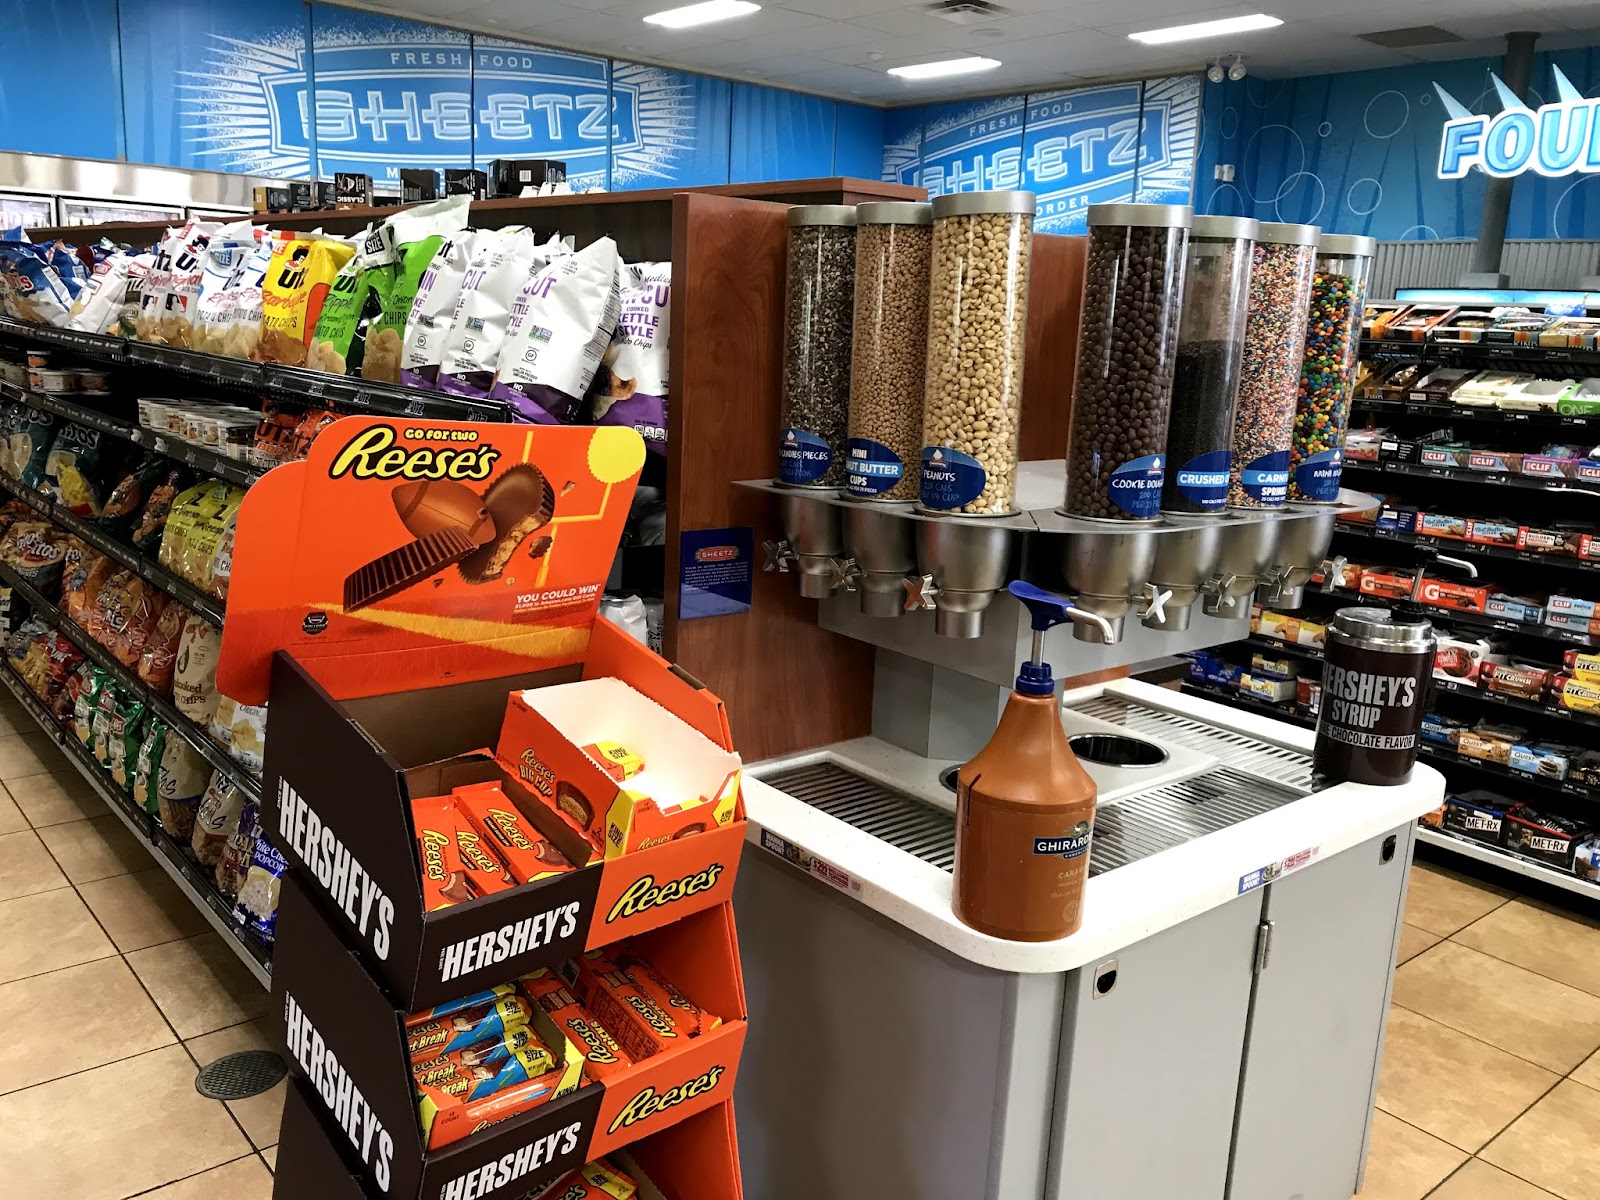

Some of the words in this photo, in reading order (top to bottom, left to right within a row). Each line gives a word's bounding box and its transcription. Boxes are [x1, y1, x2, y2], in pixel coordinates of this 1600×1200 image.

[390, 52, 463, 66] FRESH
[478, 53, 534, 69] FOOD
[297, 90, 619, 142] SHEETZ
[969, 115, 1018, 137] FRESH
[1031, 101, 1073, 121] FOOD
[913, 117, 1147, 201] SHEETZ
[1036, 195, 1090, 216] ORDER
[365, 240, 384, 254] SIZE
[215, 252, 232, 266] SIZE
[420, 270, 438, 292] IN
[462, 269, 487, 291] CUT
[641, 284, 671, 308] CU
[512, 303, 530, 315] TTLE
[384, 311, 407, 325] CHIPS
[619, 325, 654, 339] STYLE
[633, 339, 653, 349] Chips
[456, 373, 466, 381] NO
[512, 383, 524, 392] NO
[1560, 403, 1593, 415] ONE
[257, 420, 295, 443] UTZ
[257, 442, 282, 455] BBQ
[331, 426, 500, 480] Reese's
[802, 451, 829, 461] PIECES
[852, 447, 868, 459] MINI
[1427, 453, 1446, 461] CLIF
[1475, 458, 1495, 466] CLIF
[861, 462, 899, 475] BUTTER
[1313, 469, 1332, 478] MINI
[1530, 463, 1550, 472] CLIF
[1586, 469, 1600, 477] CLI
[850, 475, 868, 486] CUPS
[923, 469, 956, 482] PEANUTS
[1180, 473, 1225, 485] CRUSHED
[1111, 479, 1145, 489] COOKIE
[942, 493, 960, 502] CUP
[701, 549, 733, 558] SHEETZ
[1582, 539, 1590, 555] CLIF
[1361, 576, 1375, 591] G
[516, 593, 539, 604] YOU
[541, 588, 576, 600] COULD
[1424, 584, 1440, 600] G
[541, 597, 572, 606] Amazon.com
[1323, 660, 1416, 708] HERSHEY'S
[1494, 671, 1505, 680] FIT
[1506, 673, 1532, 685] CRUNCH
[1578, 690, 1600, 699] CRUNC
[1332, 700, 1381, 729] SYRUP
[1331, 726, 1381, 748] CHOCOLATE
[1384, 736, 1413, 749] FLAVOR
[608, 747, 626, 757] KING
[613, 751, 630, 759] SIZE
[520, 748, 555, 783] Reese's
[519, 764, 534, 783] BIG
[534, 776, 553, 797] CUP
[720, 814, 732, 824] SIZE
[721, 808, 733, 817] KING
[487, 808, 534, 850] Reese's
[610, 822, 625, 838] KING
[608, 829, 622, 848] SIZE
[765, 832, 784, 847] WANNA
[1037, 832, 1093, 852] GHIRARDE
[456, 831, 500, 873] Reese's
[765, 840, 784, 855] SPOON?
[254, 849, 287, 872] POPCOR
[421, 829, 448, 882] Reese's
[279, 780, 395, 961] HERSHEY'S
[1243, 871, 1260, 882] WANNA
[607, 864, 722, 923] Reese's
[441, 901, 580, 982] HERSHEY'S
[503, 1001, 516, 1009] KING
[506, 1006, 521, 1016] SIZE
[626, 995, 678, 1038] Reese's
[419, 1029, 448, 1047] Break
[512, 1031, 527, 1040] KING
[513, 1037, 529, 1049] SIZE
[567, 1018, 619, 1064] Reese's
[412, 1054, 450, 1073] eese's
[526, 1051, 544, 1062] SIZE
[427, 1063, 457, 1081] Break
[287, 996, 394, 1192] HERSHEY'S
[607, 1065, 725, 1135] Reese's
[441, 1115, 459, 1124] COUNT
[443, 1121, 582, 1200] HERSHEY'S
